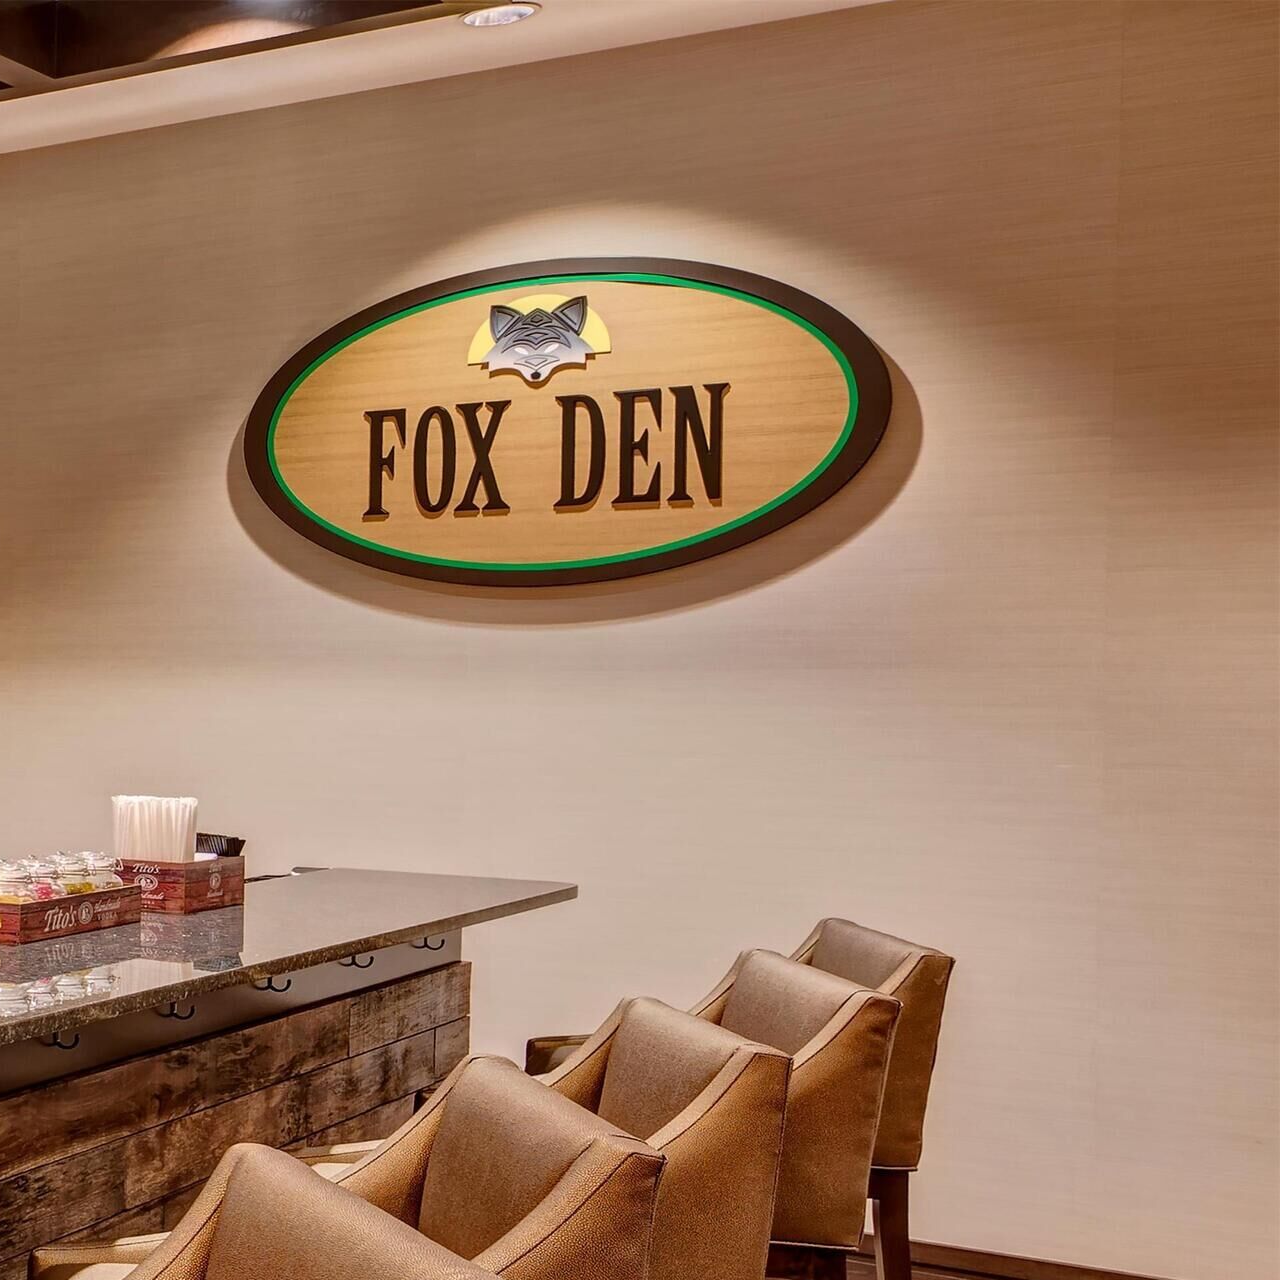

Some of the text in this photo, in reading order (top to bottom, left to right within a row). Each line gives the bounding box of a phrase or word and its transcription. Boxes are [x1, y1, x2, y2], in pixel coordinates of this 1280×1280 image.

[361, 382, 731, 523] FOX DEN
[132, 862, 161, 875] Tito's
